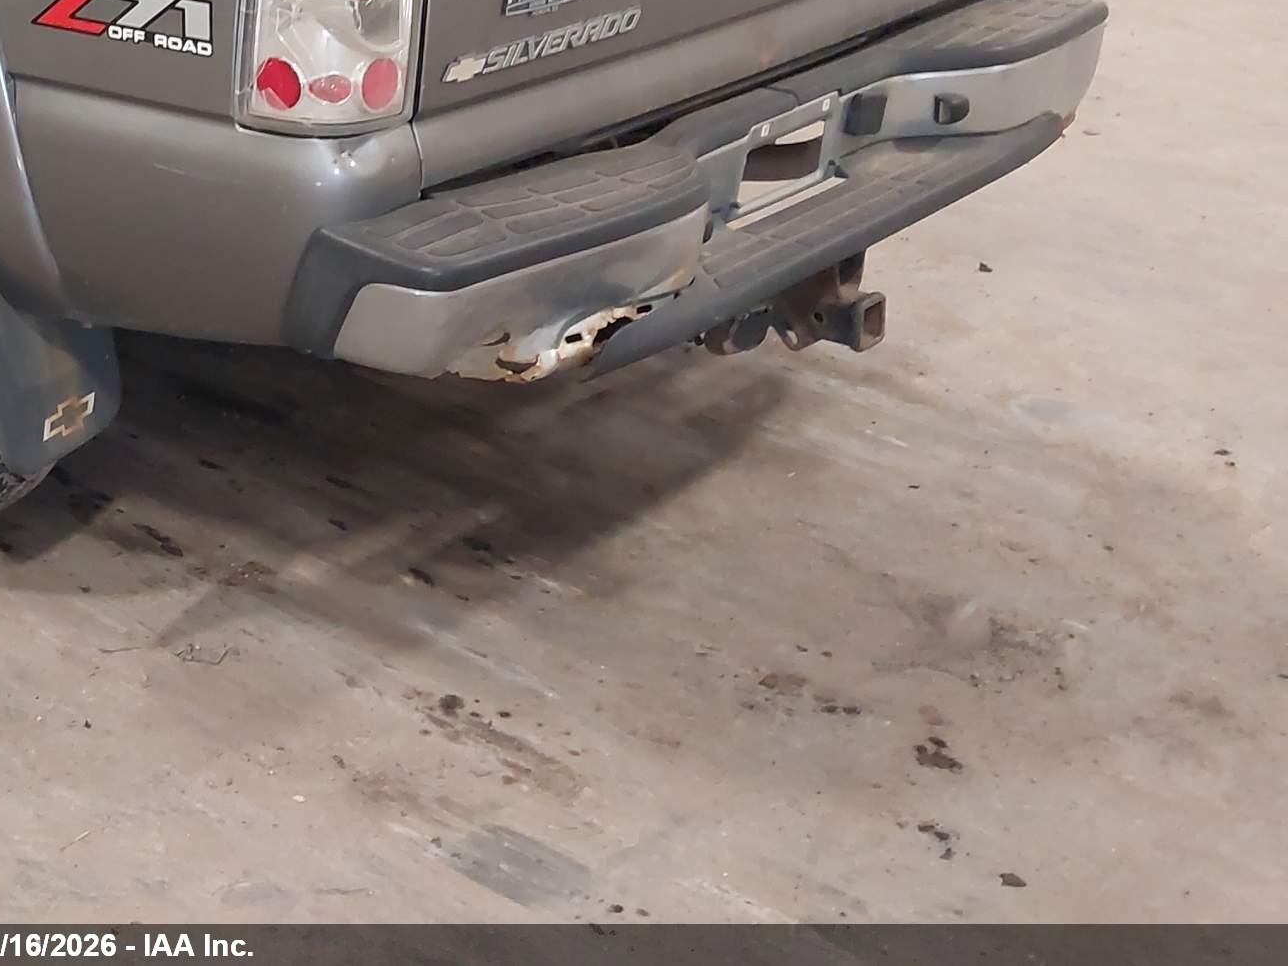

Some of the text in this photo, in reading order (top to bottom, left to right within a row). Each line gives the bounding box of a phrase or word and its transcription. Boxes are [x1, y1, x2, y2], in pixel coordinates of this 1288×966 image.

[108, 25, 213, 56] OFF ROAD
[483, 6, 642, 74] SILVERADO
